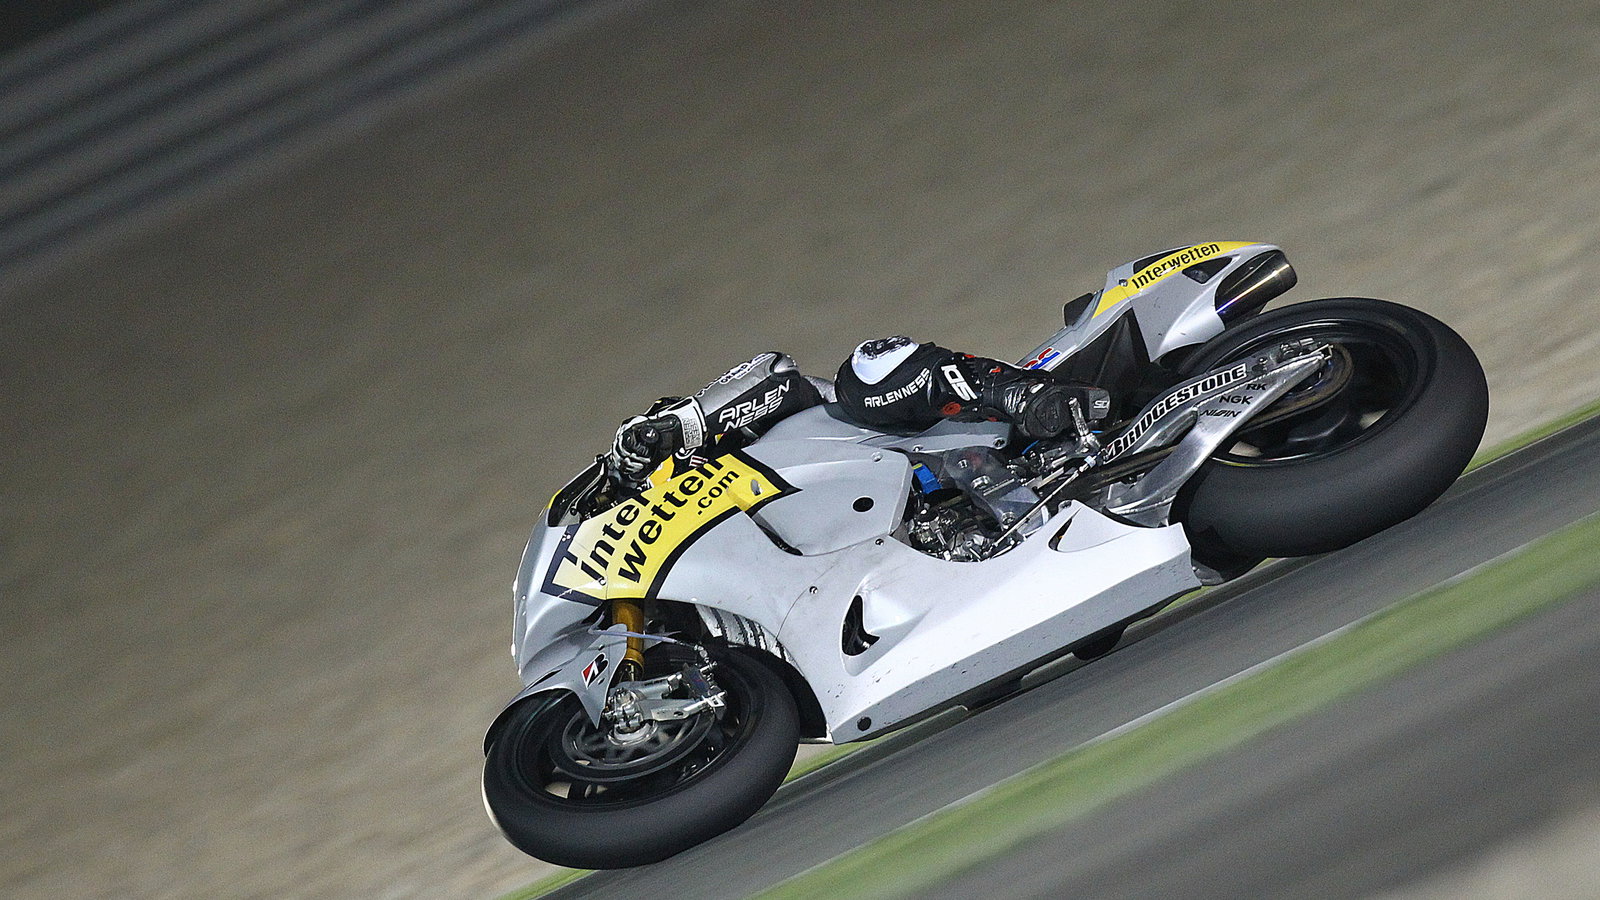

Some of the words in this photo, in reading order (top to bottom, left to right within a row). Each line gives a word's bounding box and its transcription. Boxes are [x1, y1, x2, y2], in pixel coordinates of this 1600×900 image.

[718, 379, 791, 424] ARLEN
[1219, 394, 1253, 405] NGK
[1246, 383, 1267, 391] RK
[723, 397, 784, 432] NESS
[697, 470, 740, 516] .com
